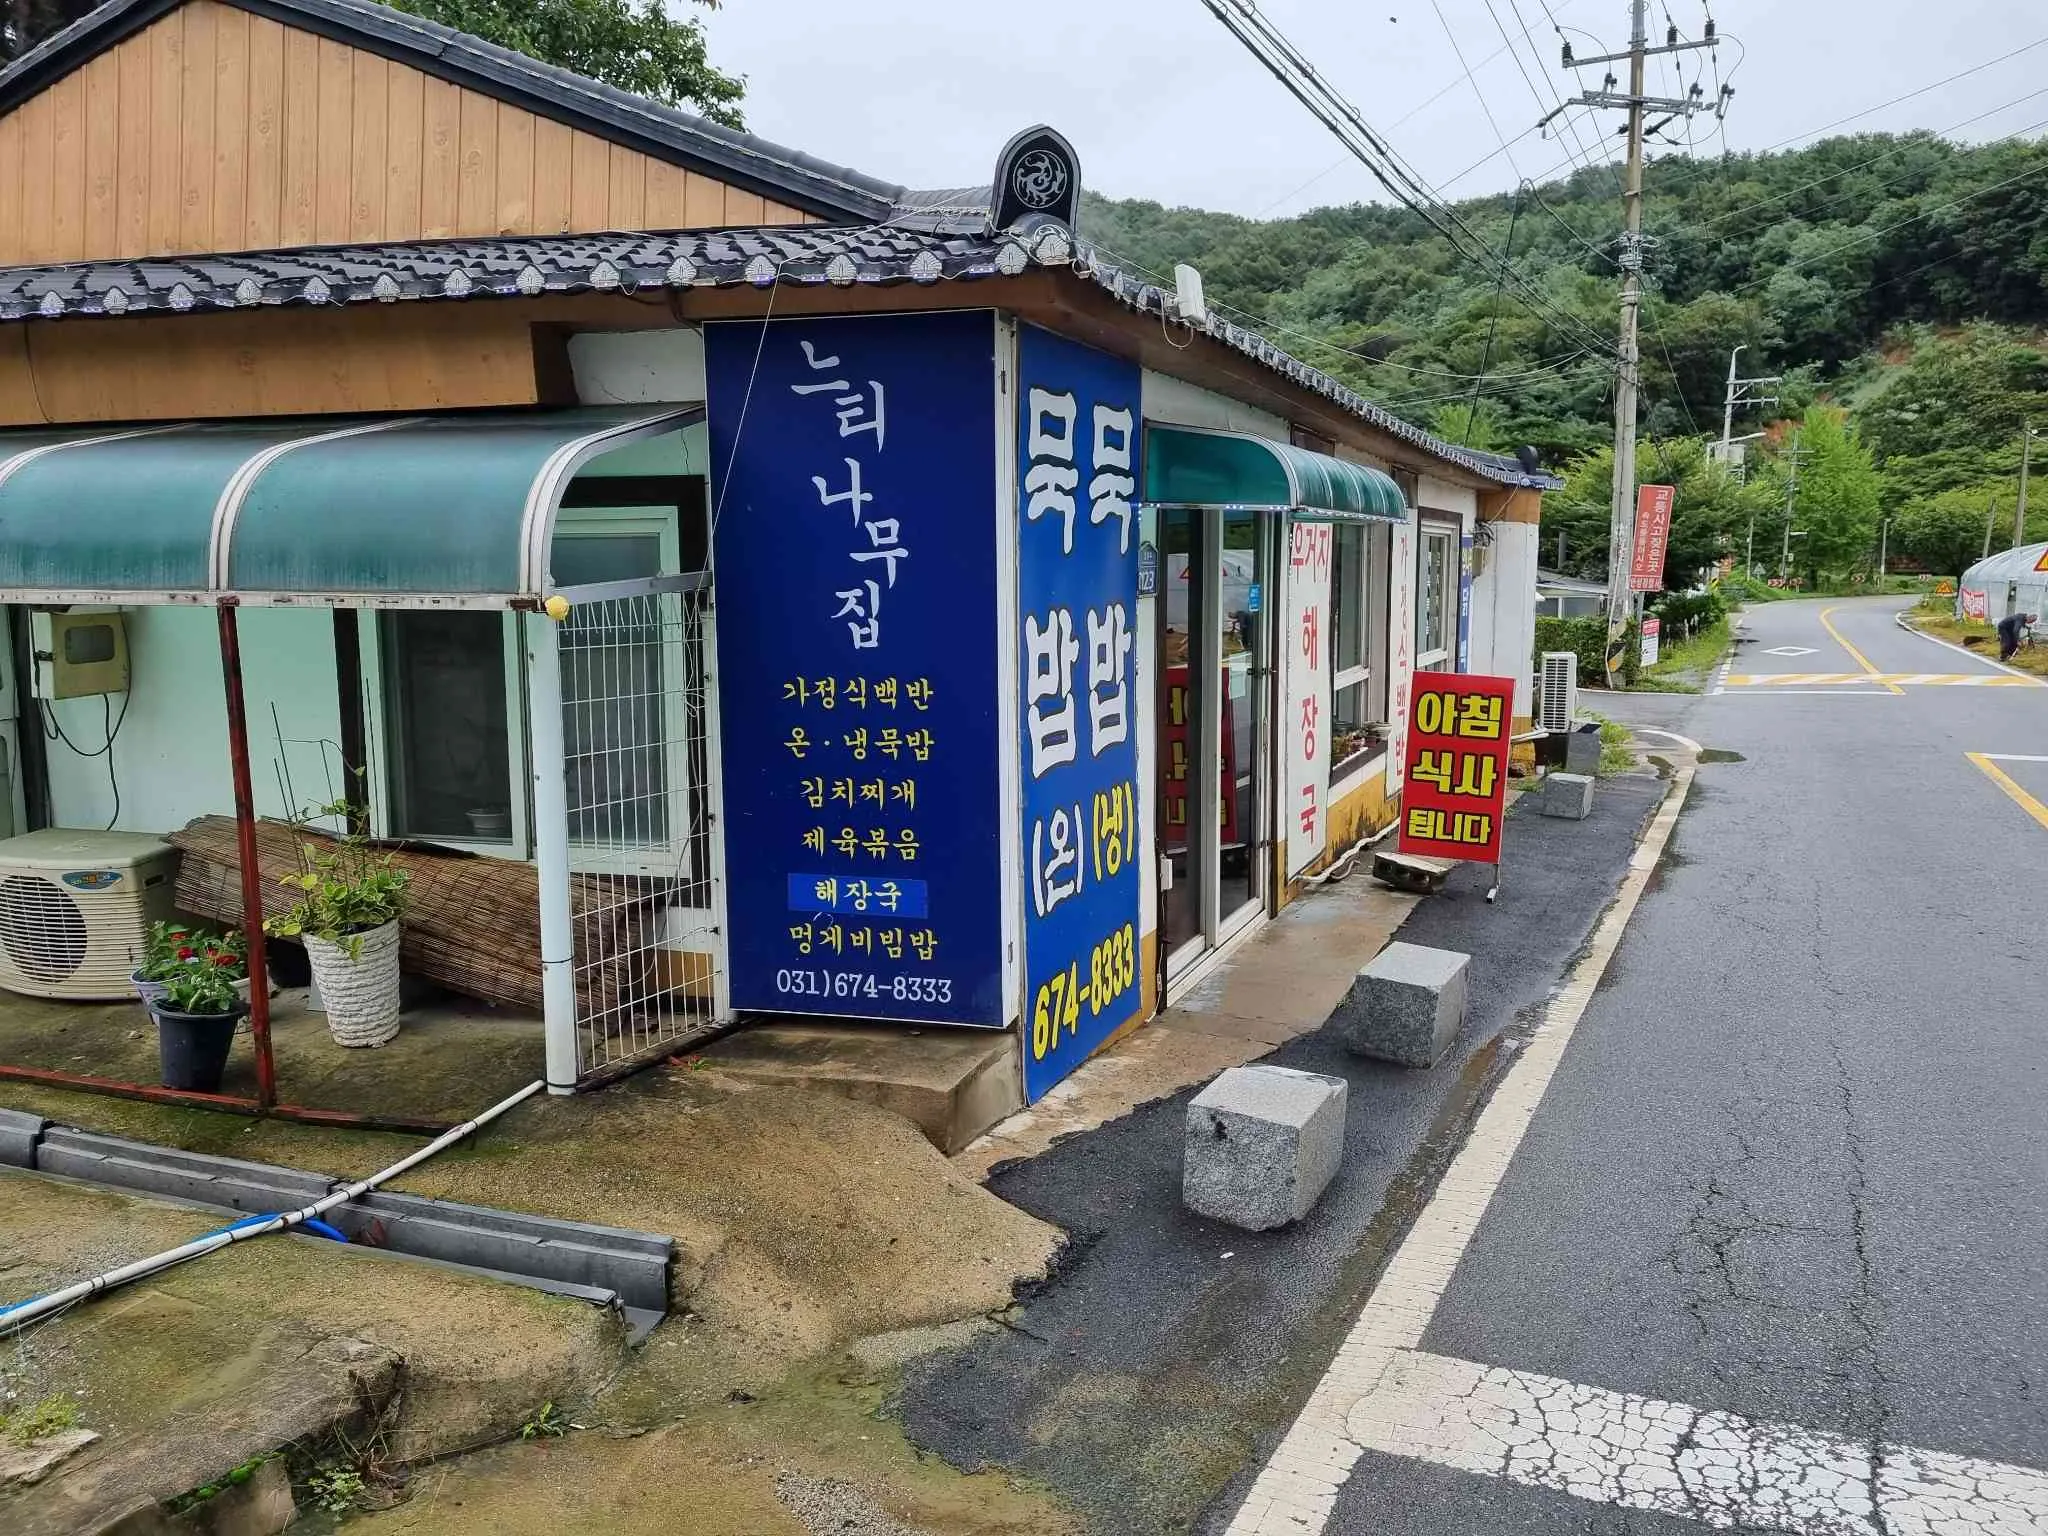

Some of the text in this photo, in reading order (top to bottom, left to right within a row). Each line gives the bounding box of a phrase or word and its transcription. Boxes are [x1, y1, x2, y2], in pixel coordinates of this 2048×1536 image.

[790, 340, 909, 650] 느티나무집
[1292, 524, 1331, 585] 우거지
[1024, 387, 1084, 918] 묵밥 (온)
[1088, 404, 1135, 881] 묵밥 (냉)
[783, 676, 935, 711] 가정식백반
[1416, 691, 1503, 739] 아침
[1300, 605, 1319, 845] 해장국
[800, 776, 916, 812] 김치찌개
[1411, 750, 1497, 798] 식사
[801, 825, 920, 861] 제육볶음
[1407, 809, 1491, 845] 됩니다
[814, 877, 902, 913] 해장국
[789, 922, 938, 961] 멍게비빔밥
[776, 969, 952, 1004] 031)674-8333
[1033, 922, 1134, 1062] 674-8333
